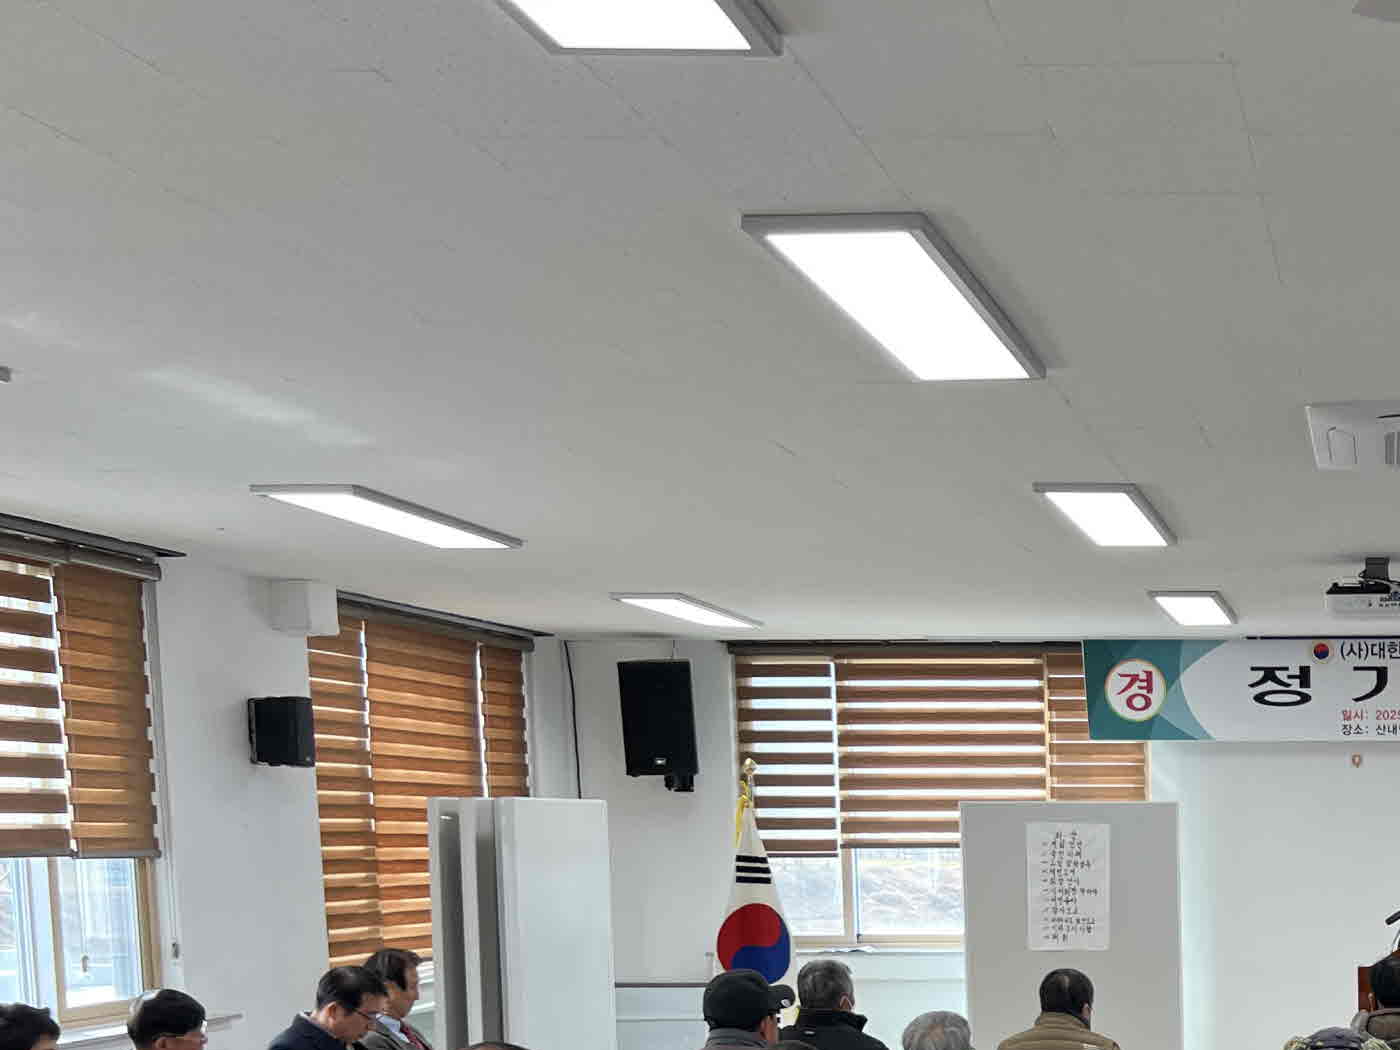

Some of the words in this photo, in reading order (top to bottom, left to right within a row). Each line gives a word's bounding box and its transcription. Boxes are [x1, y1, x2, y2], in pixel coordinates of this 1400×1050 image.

[1117, 668, 1155, 713] 경
[1342, 708, 1369, 721] 일시:
[1341, 723, 1369, 736] 장소:
